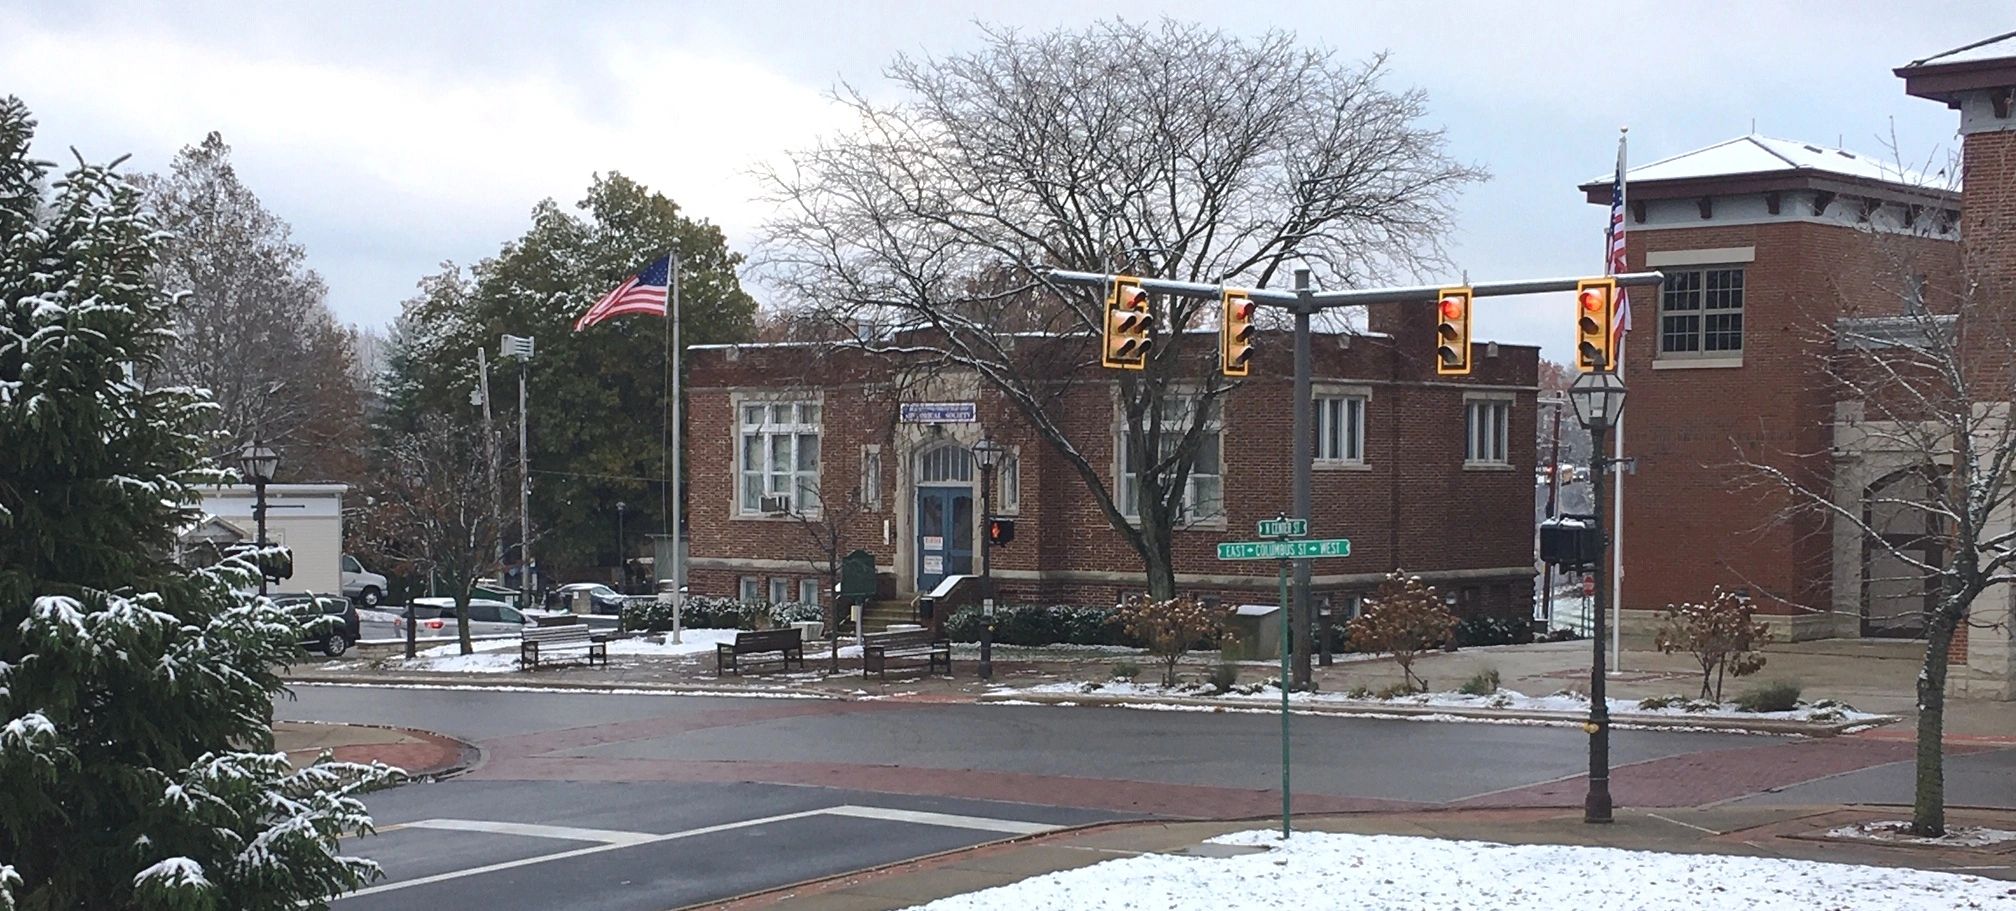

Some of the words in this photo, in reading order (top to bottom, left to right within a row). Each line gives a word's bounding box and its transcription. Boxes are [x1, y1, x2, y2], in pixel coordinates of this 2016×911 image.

[1271, 522, 1292, 535] CENTER
[1293, 521, 1300, 535] ST
[1226, 545, 1246, 557] EAST
[1256, 543, 1296, 557] COLUMBUS
[1298, 543, 1307, 556] ST
[1320, 542, 1340, 555] WEST
